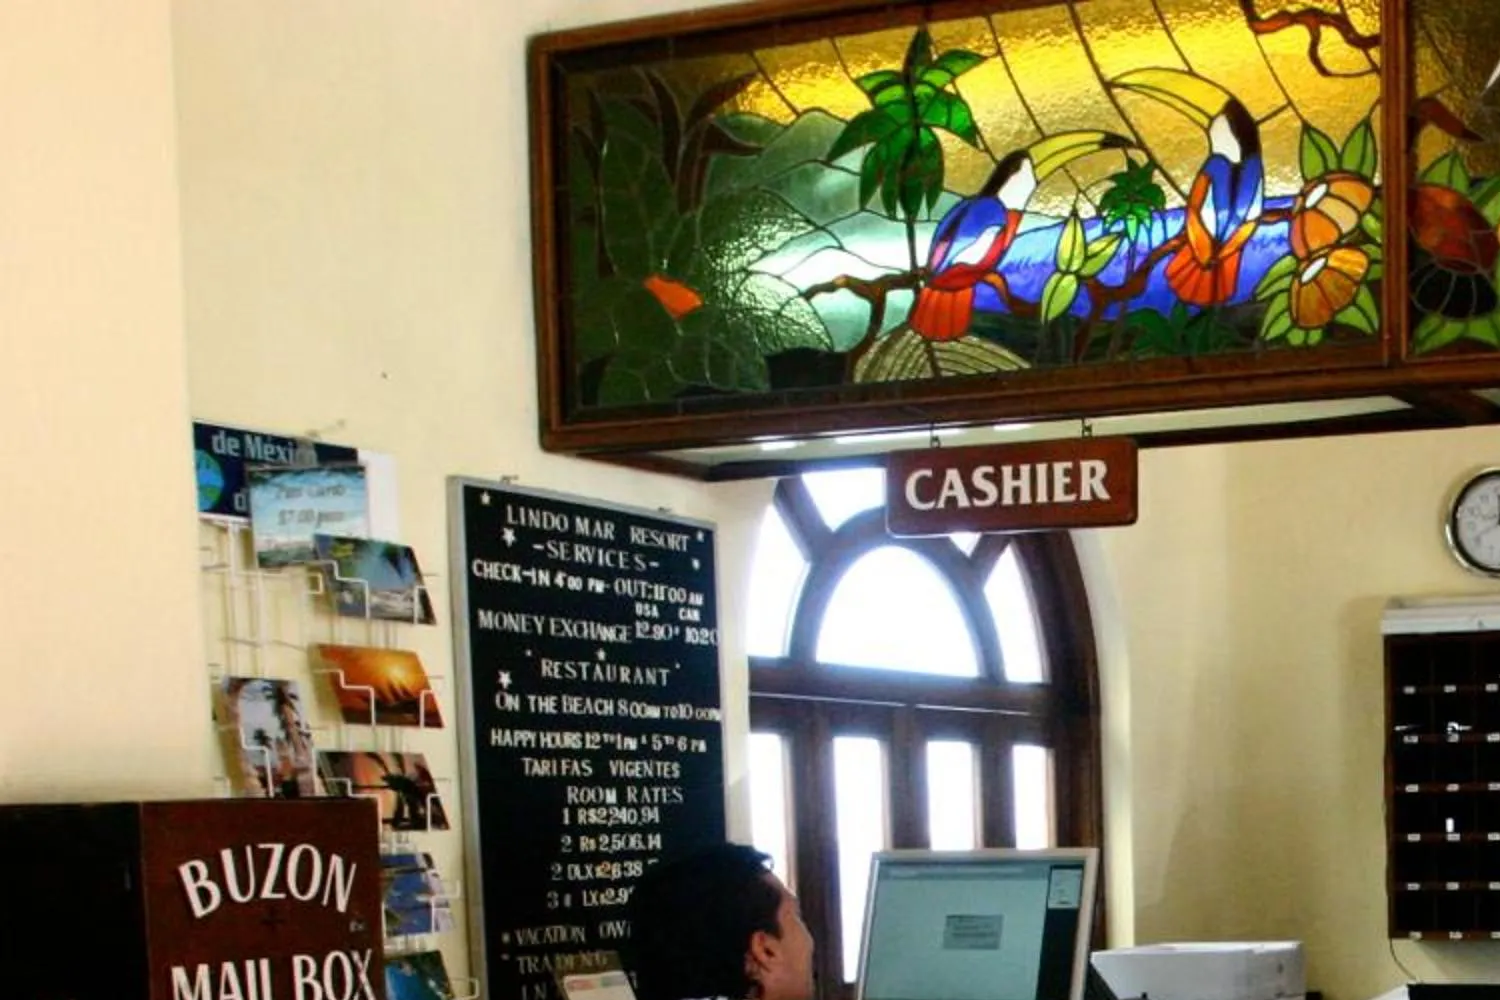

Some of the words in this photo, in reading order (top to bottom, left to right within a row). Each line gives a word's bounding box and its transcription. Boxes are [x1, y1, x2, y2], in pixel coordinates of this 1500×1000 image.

[211, 430, 241, 457] de
[904, 459, 1111, 511] CASHIER
[506, 504, 569, 532] LINDO
[575, 516, 615, 541] MAR
[629, 525, 690, 552] RESORT
[472, 558, 550, 587] CHECK-IN
[635, 601, 659, 618] USA
[678, 608, 701, 621] CAN
[478, 608, 544, 635] MONEY
[549, 617, 632, 643] EXCHANGE
[541, 657, 670, 687] RESTAURANT
[496, 691, 520, 712] ON
[527, 694, 559, 715] THE
[562, 694, 615, 716] BEACH
[491, 728, 537, 748] HAPPY
[540, 731, 583, 749] HOURS
[584, 731, 602, 749] 12
[651, 733, 663, 751] 5
[676, 735, 688, 752] 6
[521, 757, 594, 777] TARIFAS
[609, 760, 681, 779] VIGENTES
[566, 785, 617, 804] ROOM
[626, 785, 684, 803] RATES
[563, 807, 570, 825] 1
[560, 835, 573, 853] 2
[178, 843, 357, 918] BUZON
[550, 862, 563, 880] 2
[513, 925, 587, 945] VACATION
